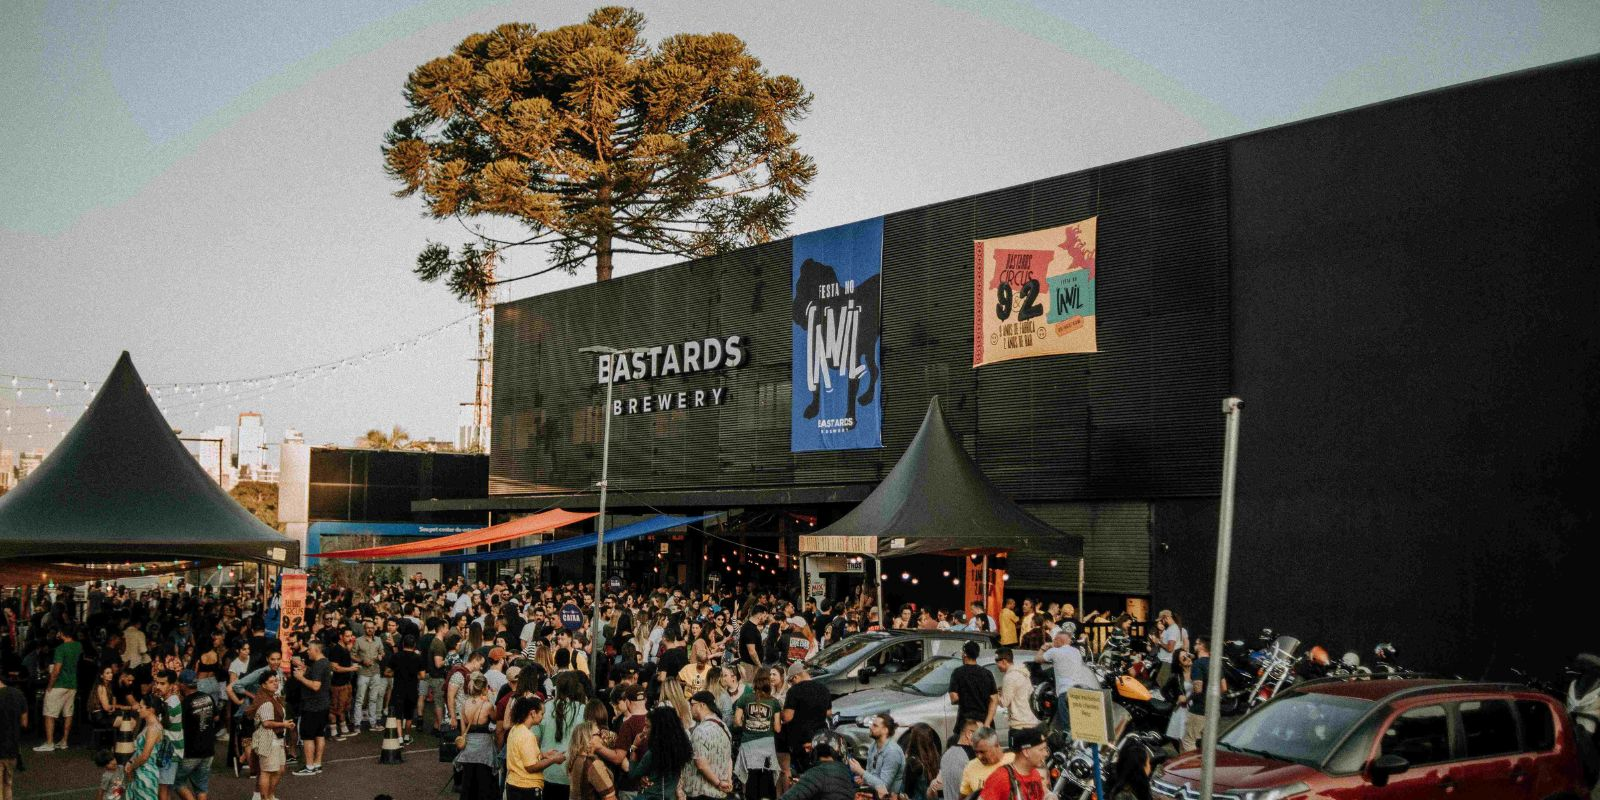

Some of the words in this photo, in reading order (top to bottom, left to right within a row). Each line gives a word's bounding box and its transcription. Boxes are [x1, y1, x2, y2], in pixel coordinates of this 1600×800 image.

[818, 282, 839, 299] FESTA
[844, 279, 855, 295] NO
[996, 282, 1013, 322] 9
[1018, 279, 1043, 321] 2
[598, 335, 742, 384] BASTARDS
[613, 387, 722, 416] BREWERY
[817, 417, 854, 428] BASTARDS
[562, 614, 581, 622] CAIXA
